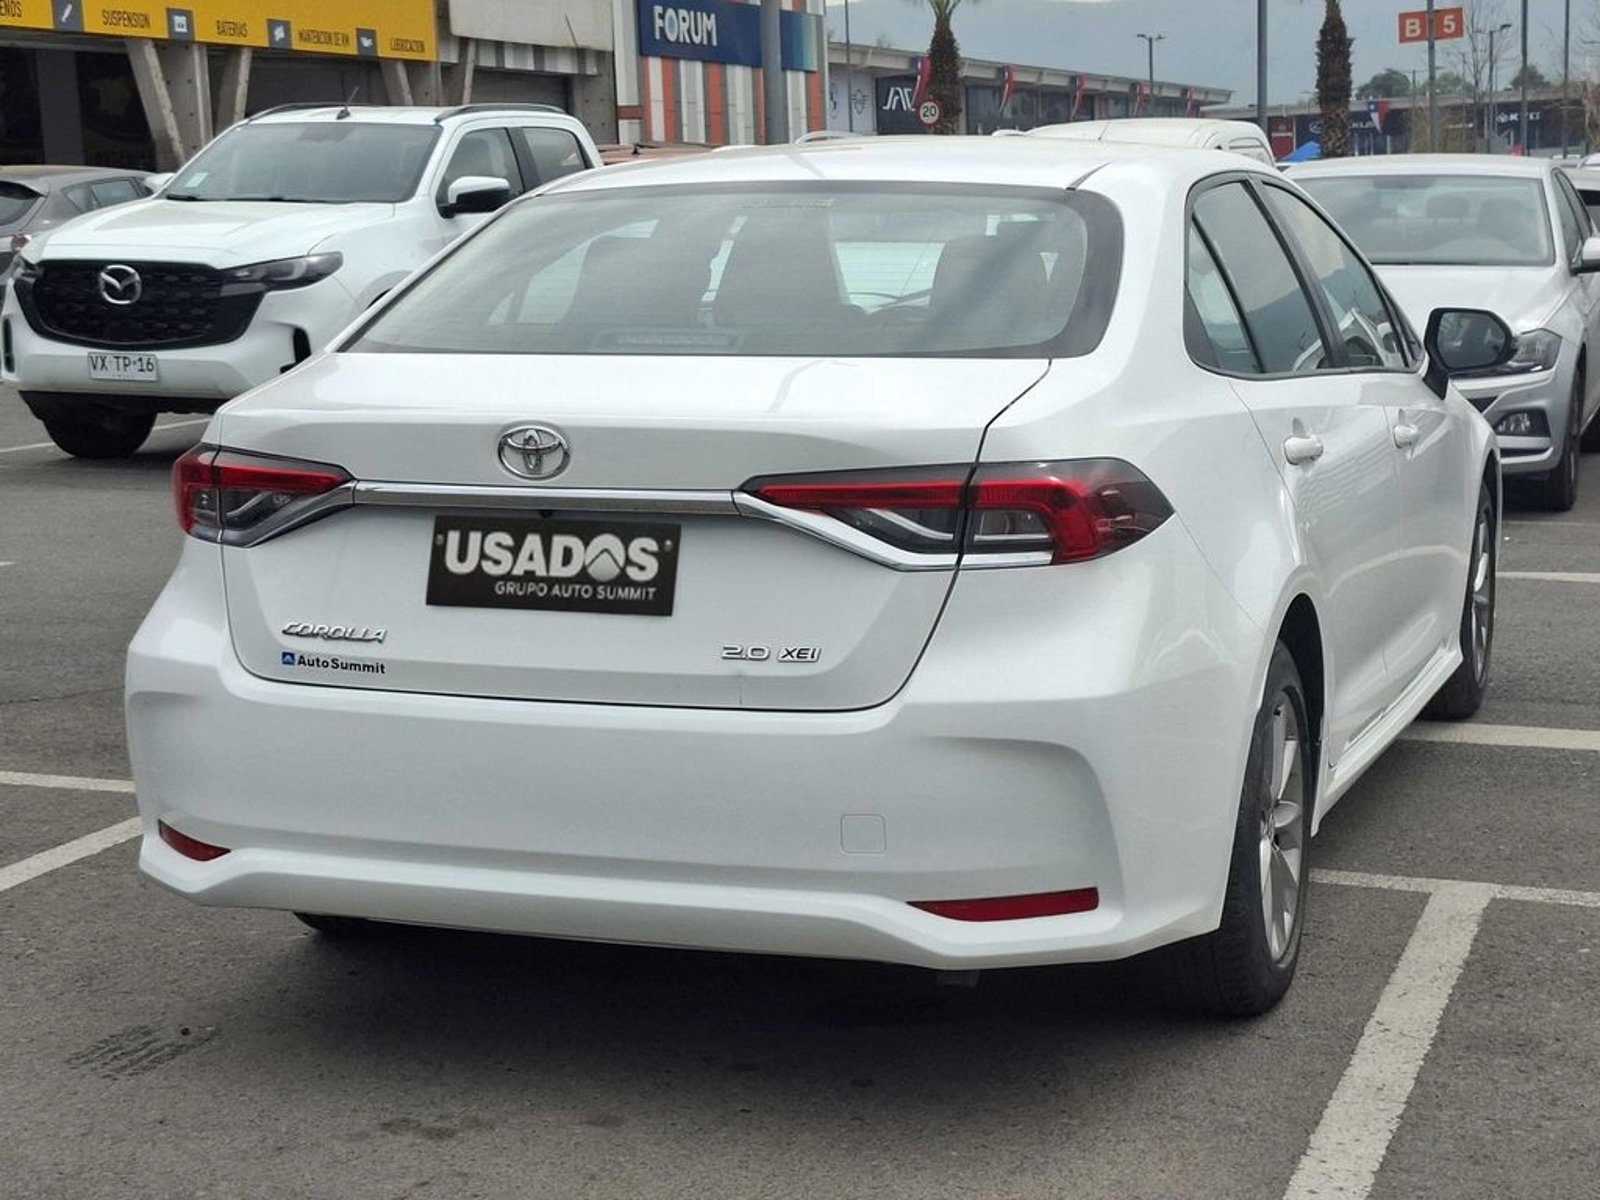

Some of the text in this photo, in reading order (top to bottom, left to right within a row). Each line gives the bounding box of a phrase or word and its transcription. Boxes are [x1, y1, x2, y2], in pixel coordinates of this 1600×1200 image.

[102, 9, 151, 29] SUSPENSION
[653, 5, 718, 47] FORUM
[1405, 15, 1456, 37] B 5
[922, 105, 937, 118] 20
[444, 529, 660, 583] USADOS
[494, 580, 657, 601] GRUPO AUTO SUMMIT
[281, 620, 388, 644] COROLLA
[721, 644, 771, 662] 2.0
